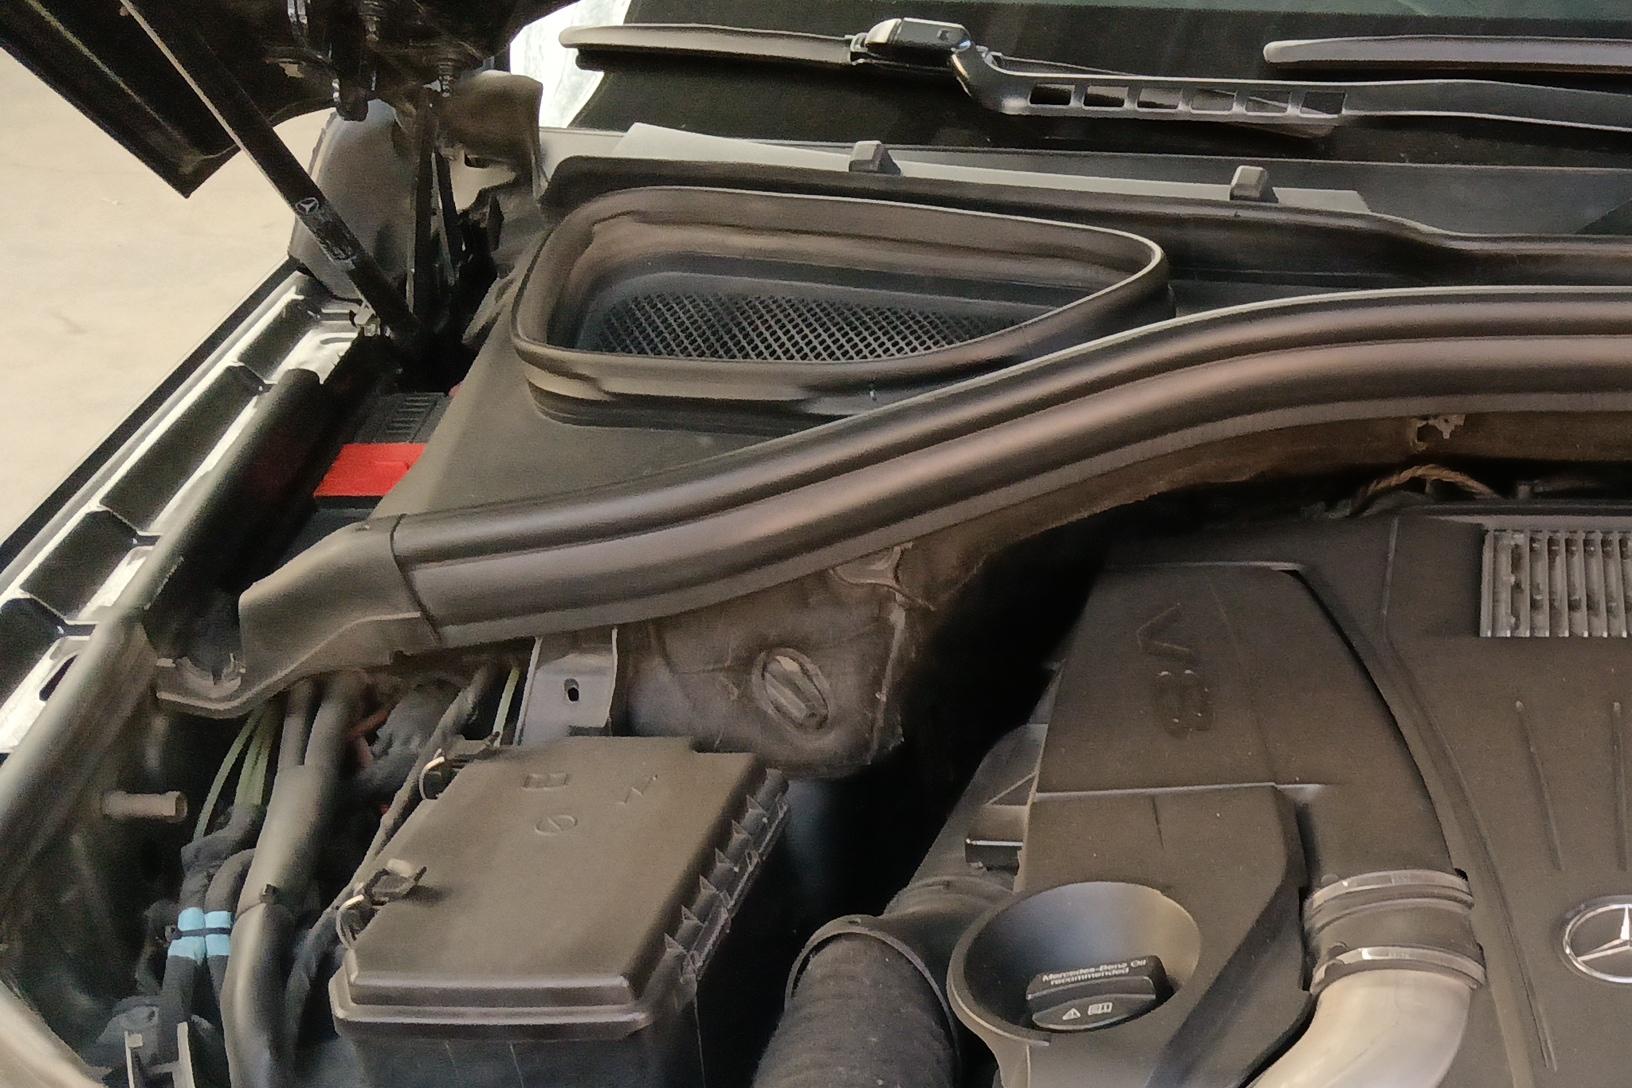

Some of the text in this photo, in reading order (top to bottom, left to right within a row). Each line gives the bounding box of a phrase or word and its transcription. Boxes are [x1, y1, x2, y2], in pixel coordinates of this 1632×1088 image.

[1135, 601, 1216, 740] V8
[1042, 959, 1147, 982] Mercedes-Benz Oil
[1050, 967, 1129, 985] recommended
